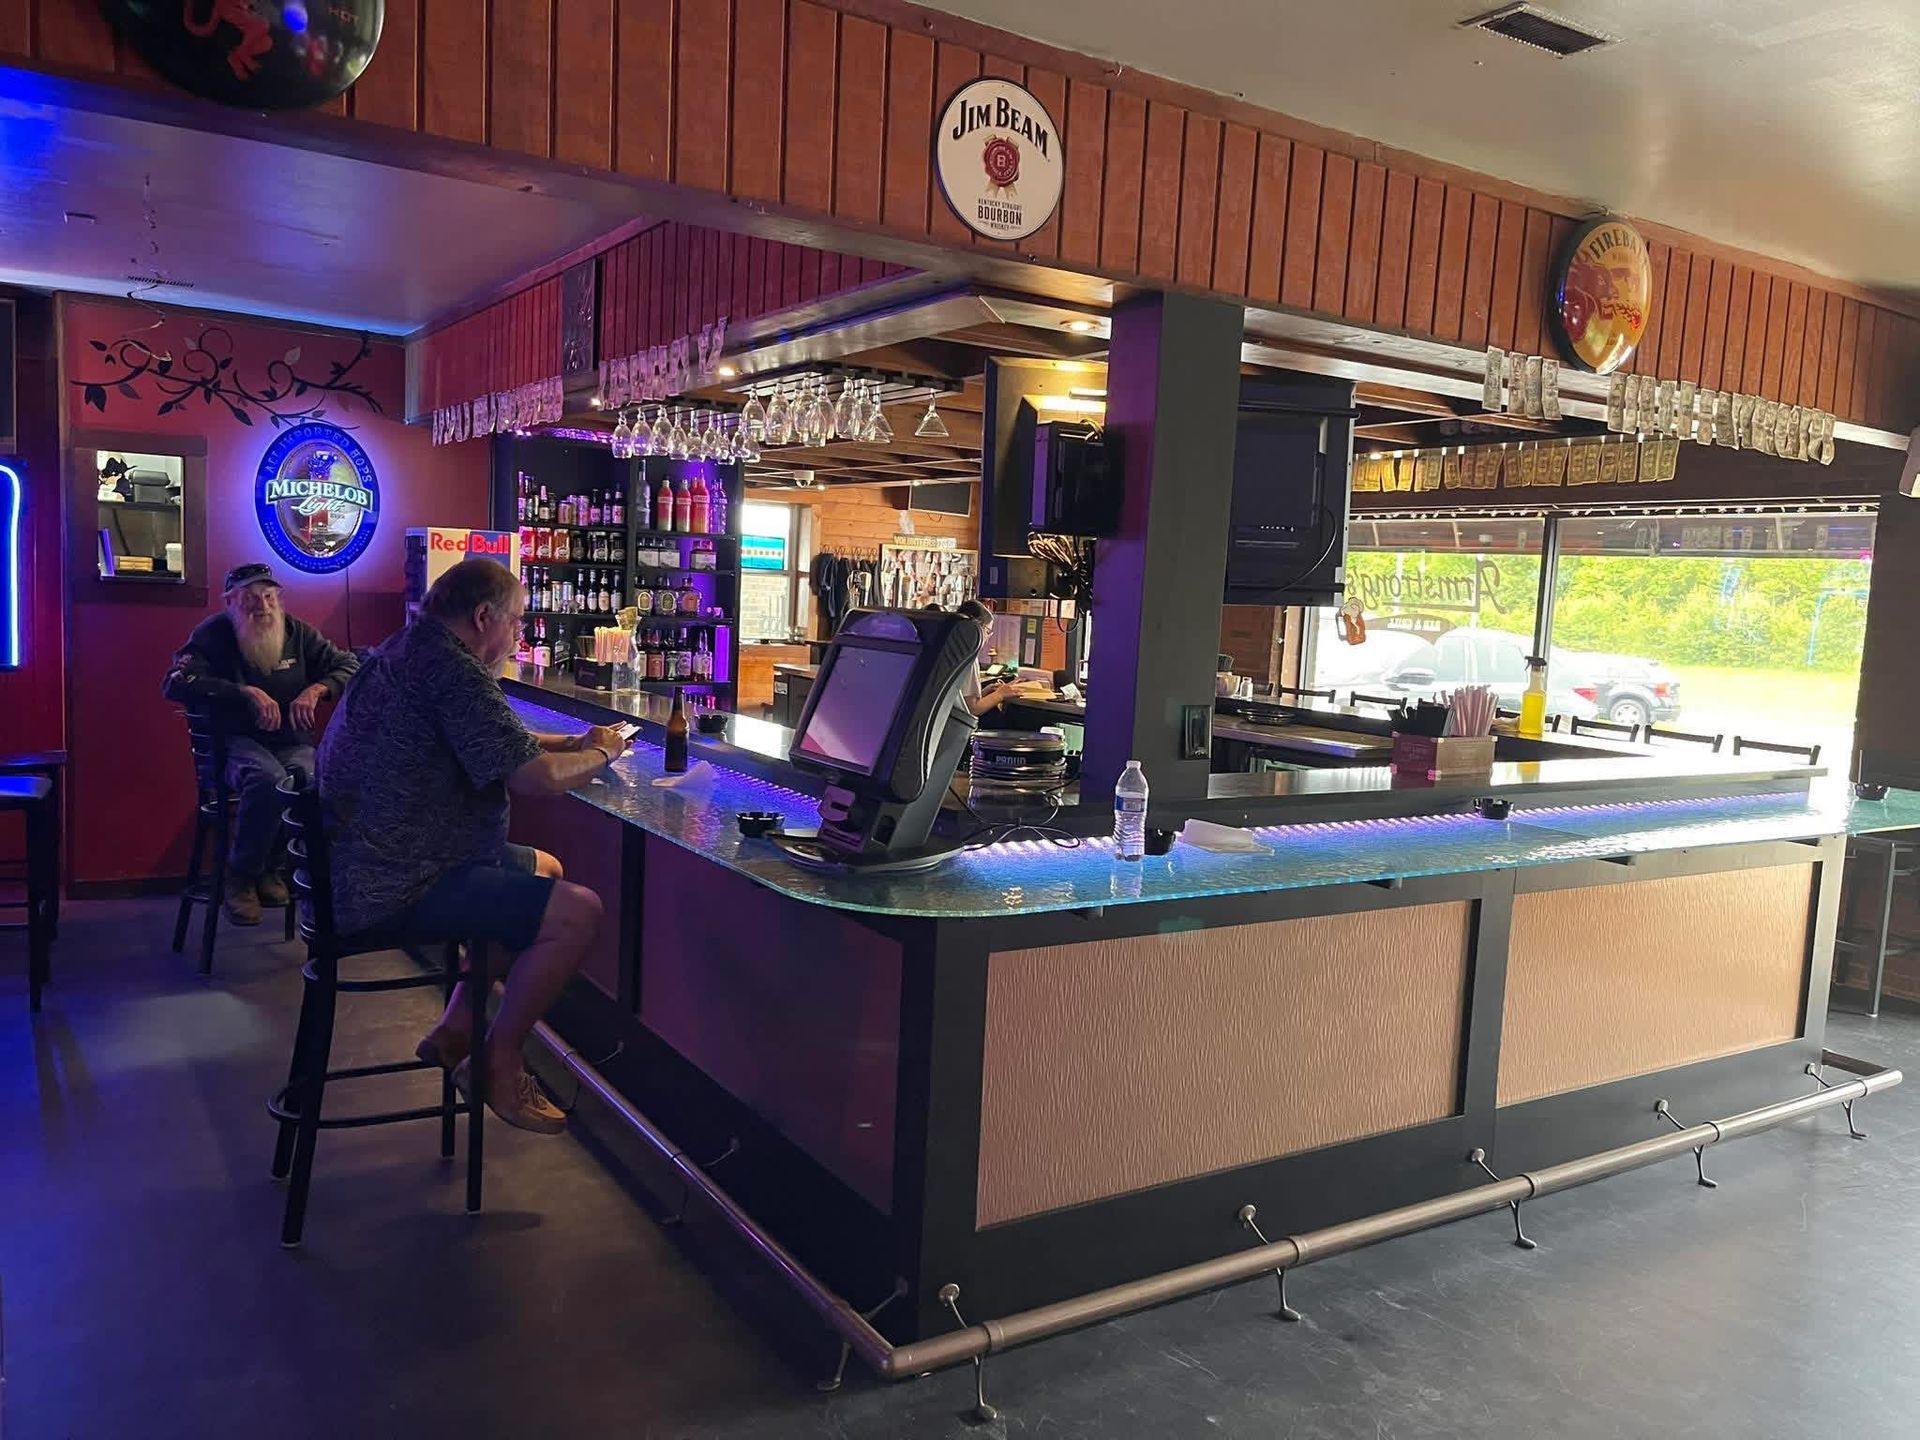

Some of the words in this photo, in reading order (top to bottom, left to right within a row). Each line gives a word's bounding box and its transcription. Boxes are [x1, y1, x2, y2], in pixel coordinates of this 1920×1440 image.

[952, 99, 992, 140] JIM
[995, 97, 1049, 159] BEAM
[978, 205, 1022, 226] BOURBON
[1589, 228, 1644, 259] FIREBA
[279, 426, 350, 449] IMPORTED
[349, 448, 373, 484] HOPS
[270, 480, 368, 505] MICHELOB
[291, 495, 346, 516] Light
[430, 531, 469, 552] Red
[471, 534, 511, 554] Bull
